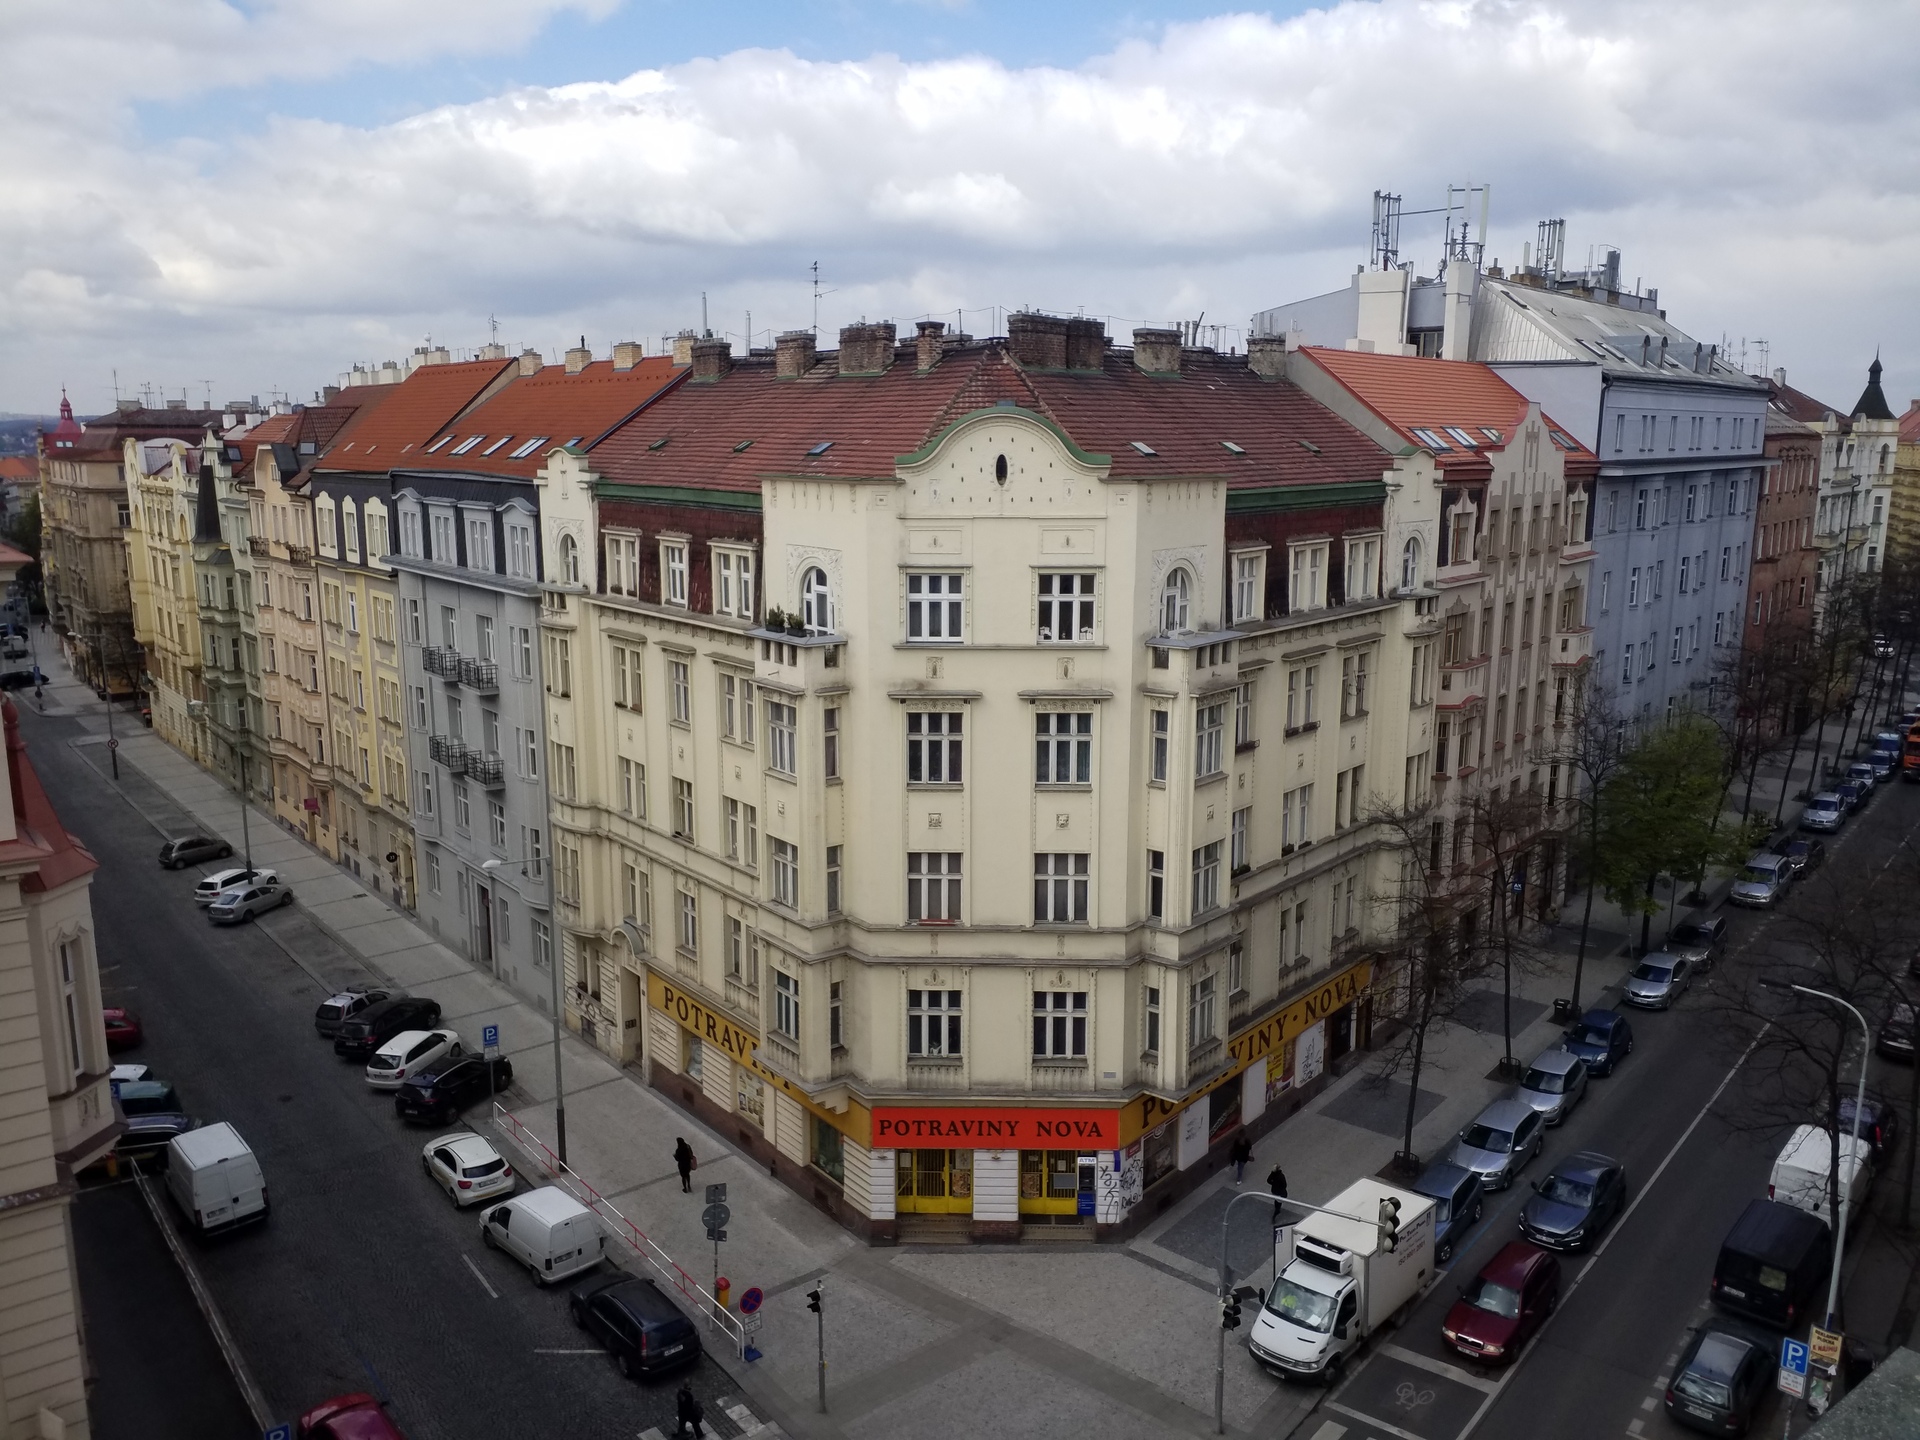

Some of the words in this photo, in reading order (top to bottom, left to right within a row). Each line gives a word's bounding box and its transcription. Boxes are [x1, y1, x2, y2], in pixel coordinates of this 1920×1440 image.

[1304, 973, 1358, 1025] NOVA
[486, 1028, 495, 1040] P
[879, 1119, 1020, 1137] POTRAVINY
[1036, 1120, 1103, 1138] NOVA
[1787, 1343, 1804, 1361] P
